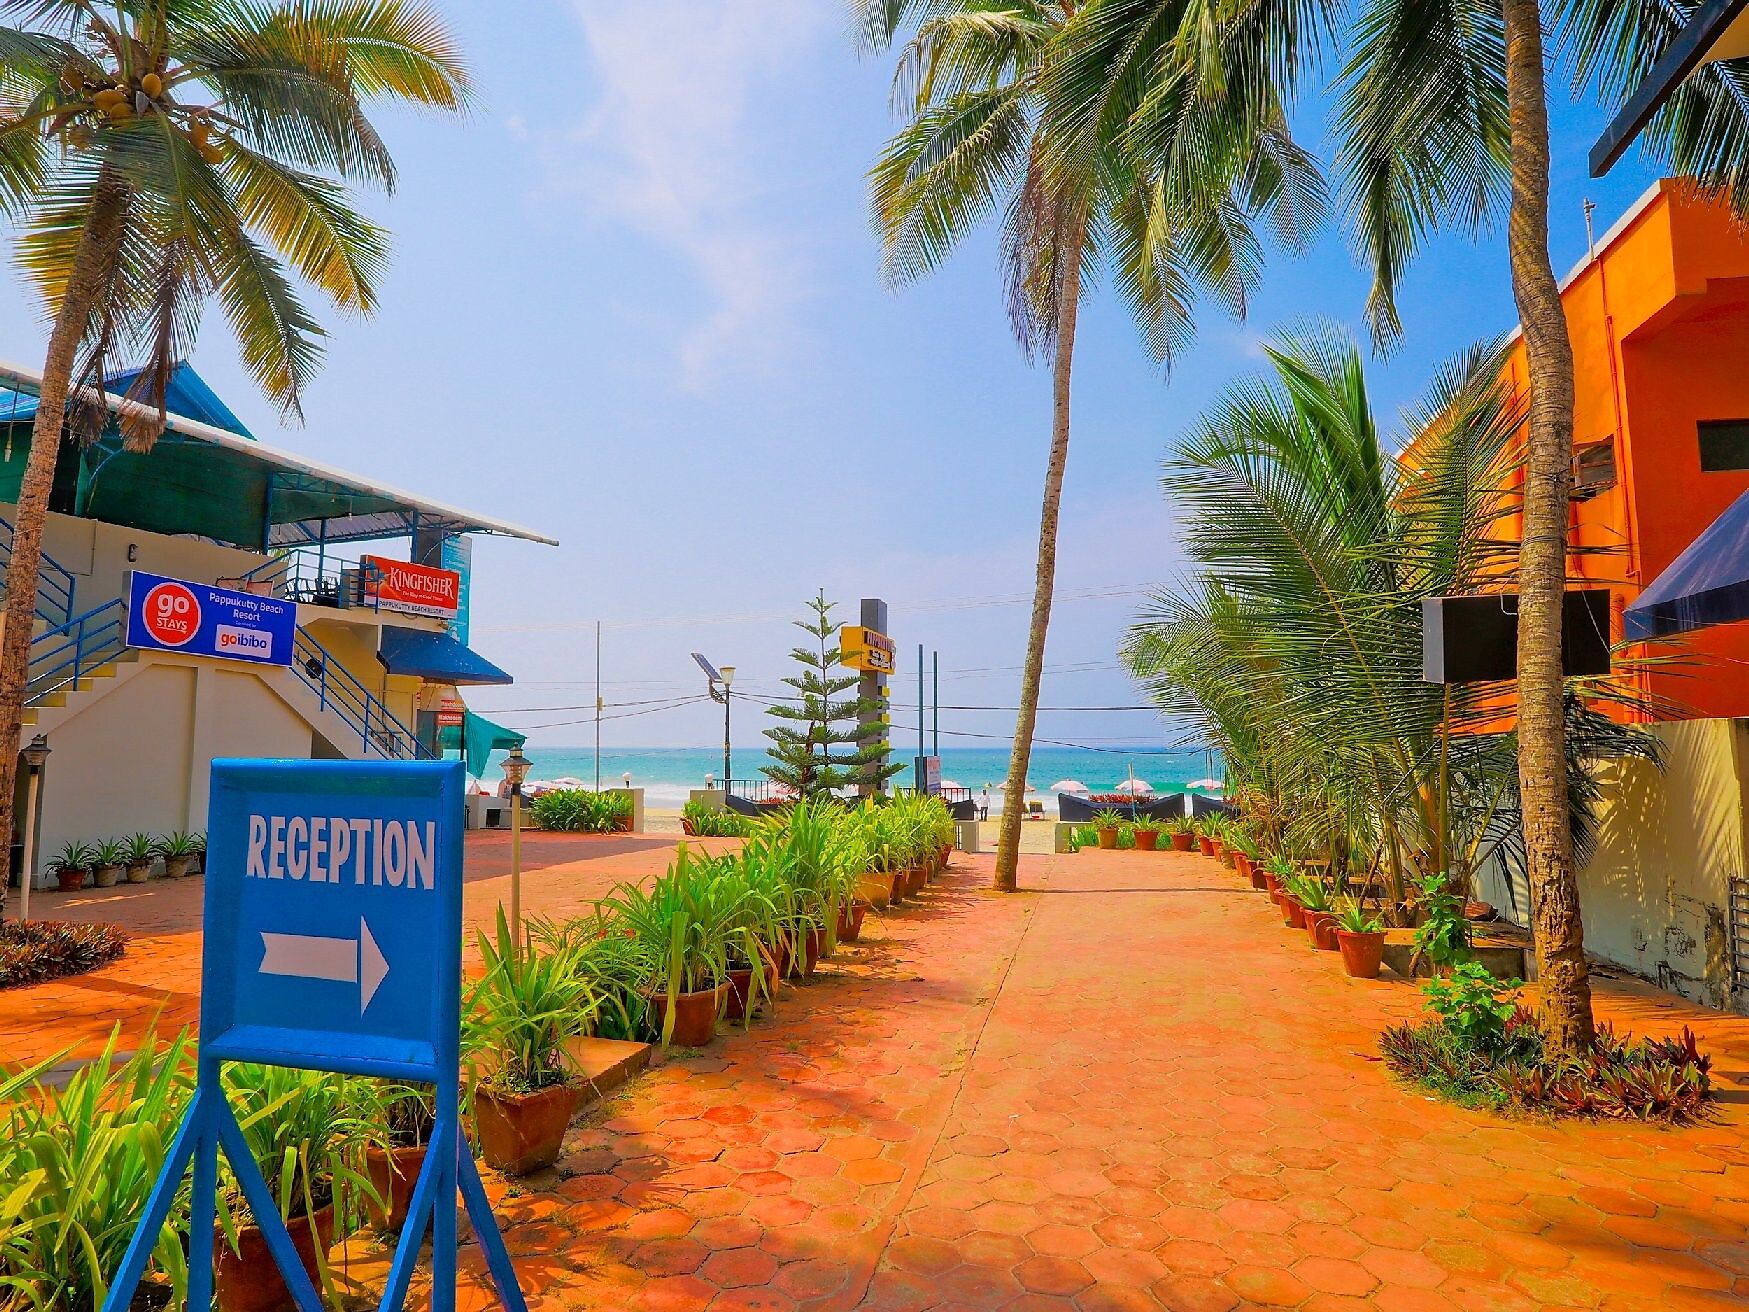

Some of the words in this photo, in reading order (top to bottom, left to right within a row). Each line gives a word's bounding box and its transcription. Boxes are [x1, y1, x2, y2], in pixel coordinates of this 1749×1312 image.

[389, 566, 454, 600] KINGFISHER
[157, 593, 190, 618] go
[209, 591, 259, 612] Pappukutty
[260, 602, 284, 614] Beach
[156, 617, 188, 631] STAYS
[233, 608, 261, 622] Resort
[221, 633, 267, 648] goibibo
[246, 814, 436, 890] RECEPTION
